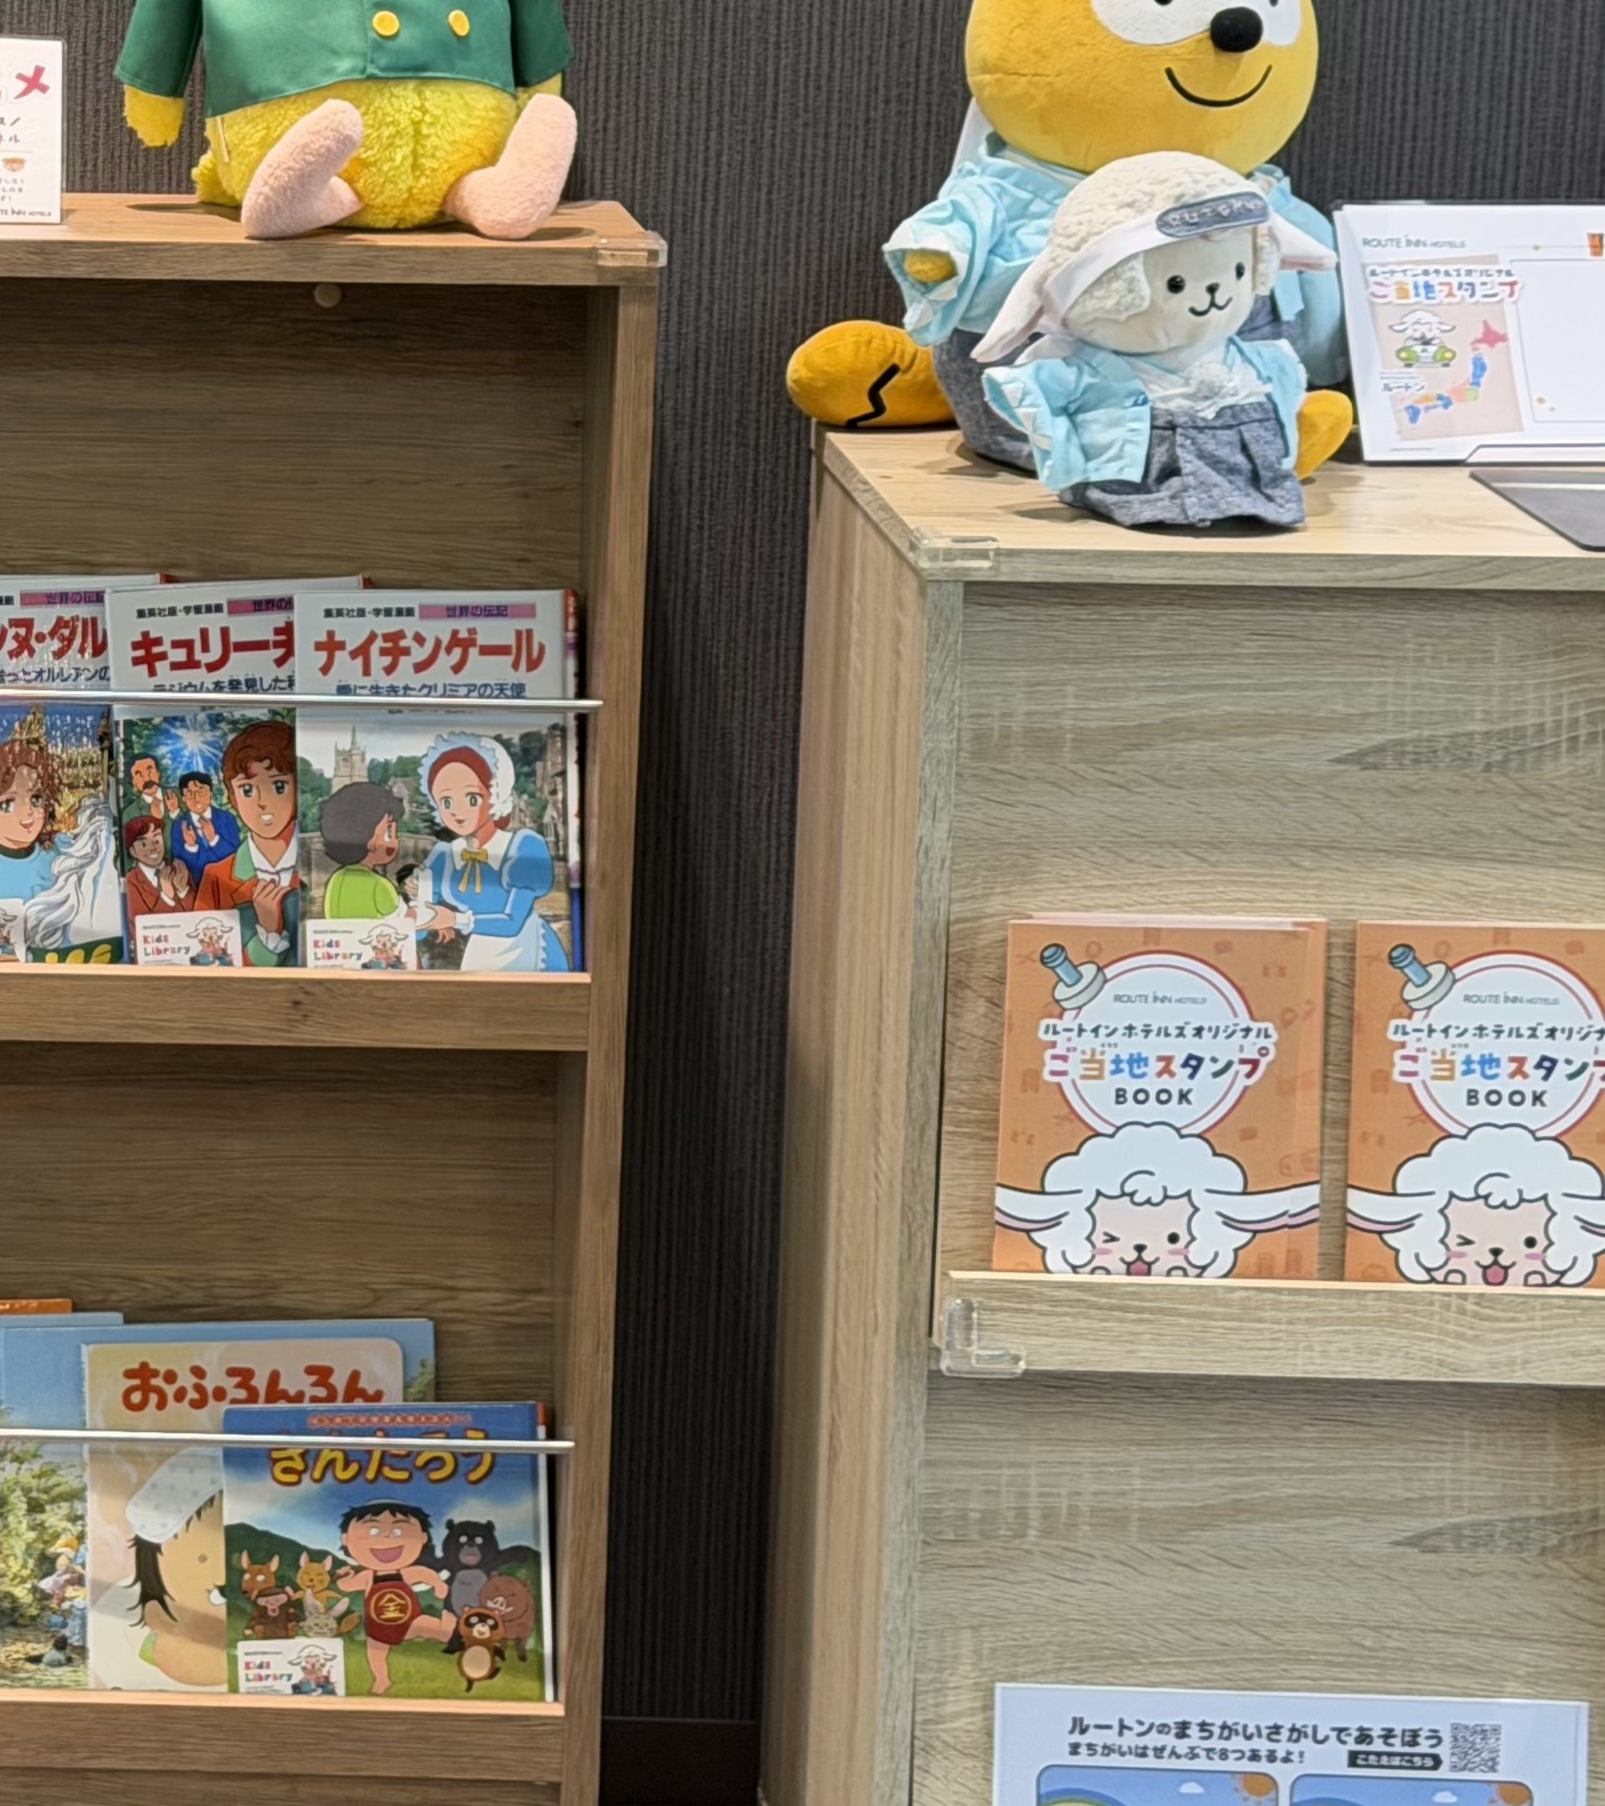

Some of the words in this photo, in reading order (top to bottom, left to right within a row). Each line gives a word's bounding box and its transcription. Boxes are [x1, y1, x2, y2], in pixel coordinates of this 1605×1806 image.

[1362, 237, 1402, 248] ROUTE
[313, 626, 546, 677] ナイチンゲール
[143, 945, 191, 957] Library
[313, 950, 363, 962] Library
[1113, 993, 1149, 1004] ROUTE
[1463, 993, 1501, 1005] ROUTE
[1043, 1021, 1273, 1040] ルートインホテルズオリジナル
[1048, 1036, 1270, 1081] ご当地スタンプ
[1114, 1087, 1194, 1106] BOOK
[1466, 1088, 1548, 1107] BOOK
[1067, 1715, 1444, 1749] ルートンのまちがいさがしであそぼう
[1067, 1741, 1306, 1764] まちがいはぜんぶで8つあるよ!
